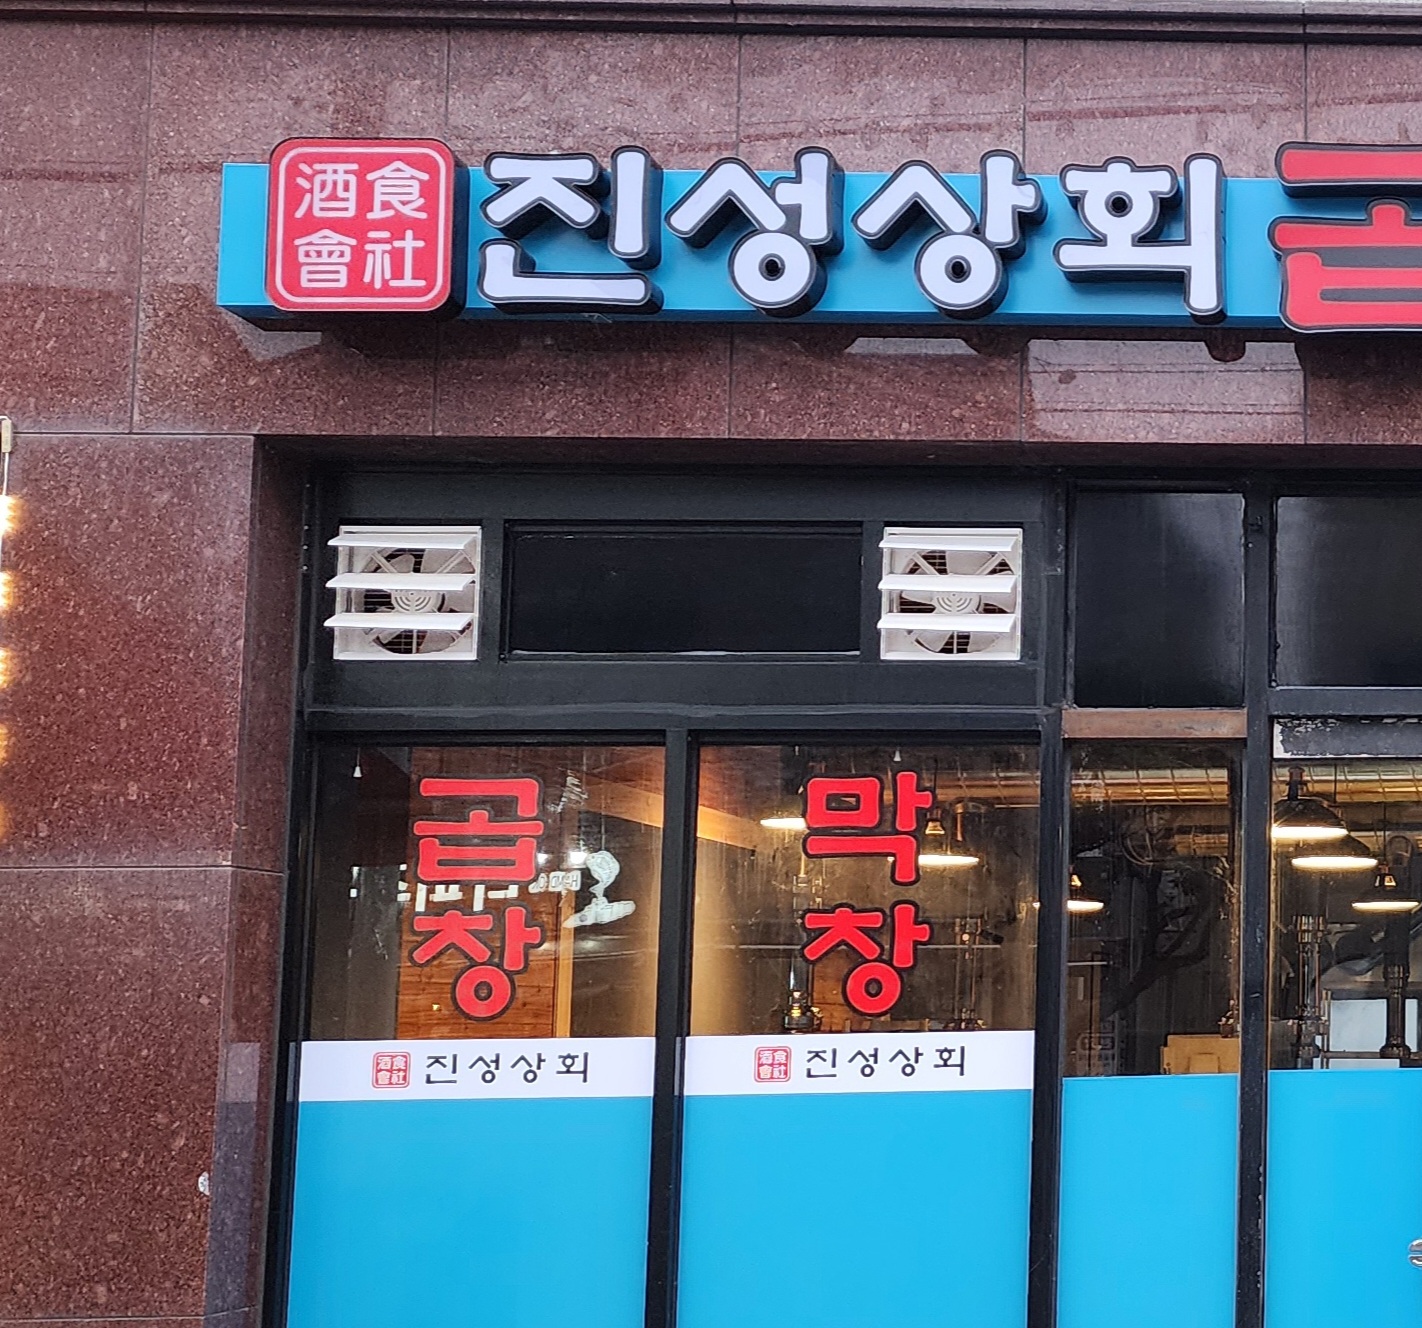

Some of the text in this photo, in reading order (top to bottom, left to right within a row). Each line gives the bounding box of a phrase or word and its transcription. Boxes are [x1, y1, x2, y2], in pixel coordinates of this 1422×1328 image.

[294, 160, 429, 221] 酒食
[294, 229, 427, 289] 會社
[481, 146, 1223, 317] 진성상회
[411, 776, 546, 1020] 곱창
[803, 770, 934, 1016] 막창
[425, 1052, 589, 1084] 진성상회
[806, 1045, 966, 1078] 진성상회
